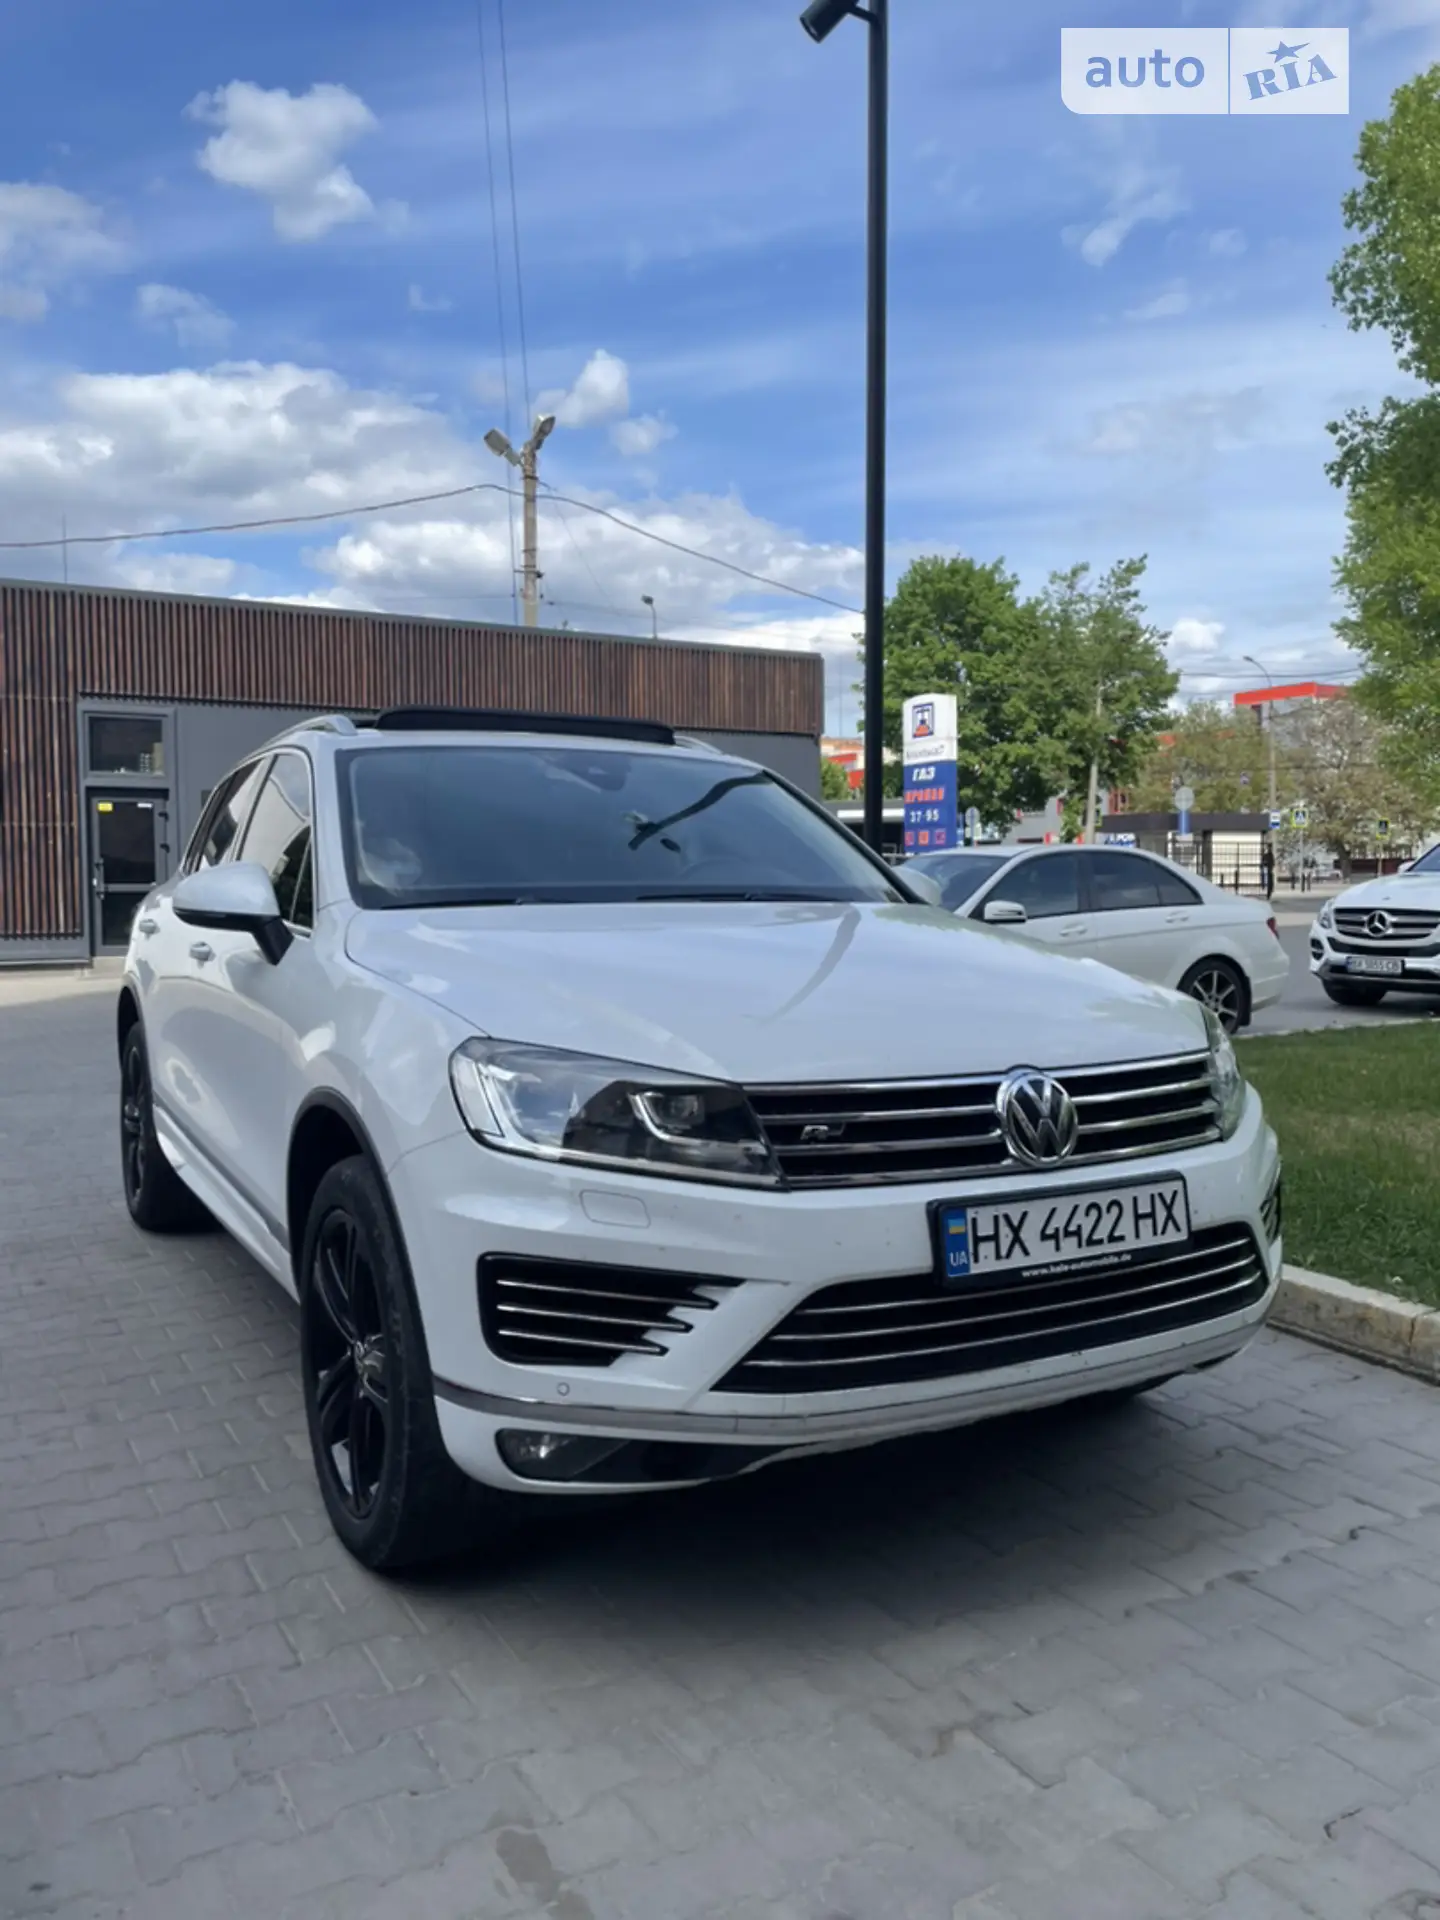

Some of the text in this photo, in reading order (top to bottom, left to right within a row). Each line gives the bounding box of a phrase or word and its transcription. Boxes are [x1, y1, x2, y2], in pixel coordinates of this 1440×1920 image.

[971, 1189, 1182, 1264] HX 4422 HX
[950, 1250, 968, 1267] UA
